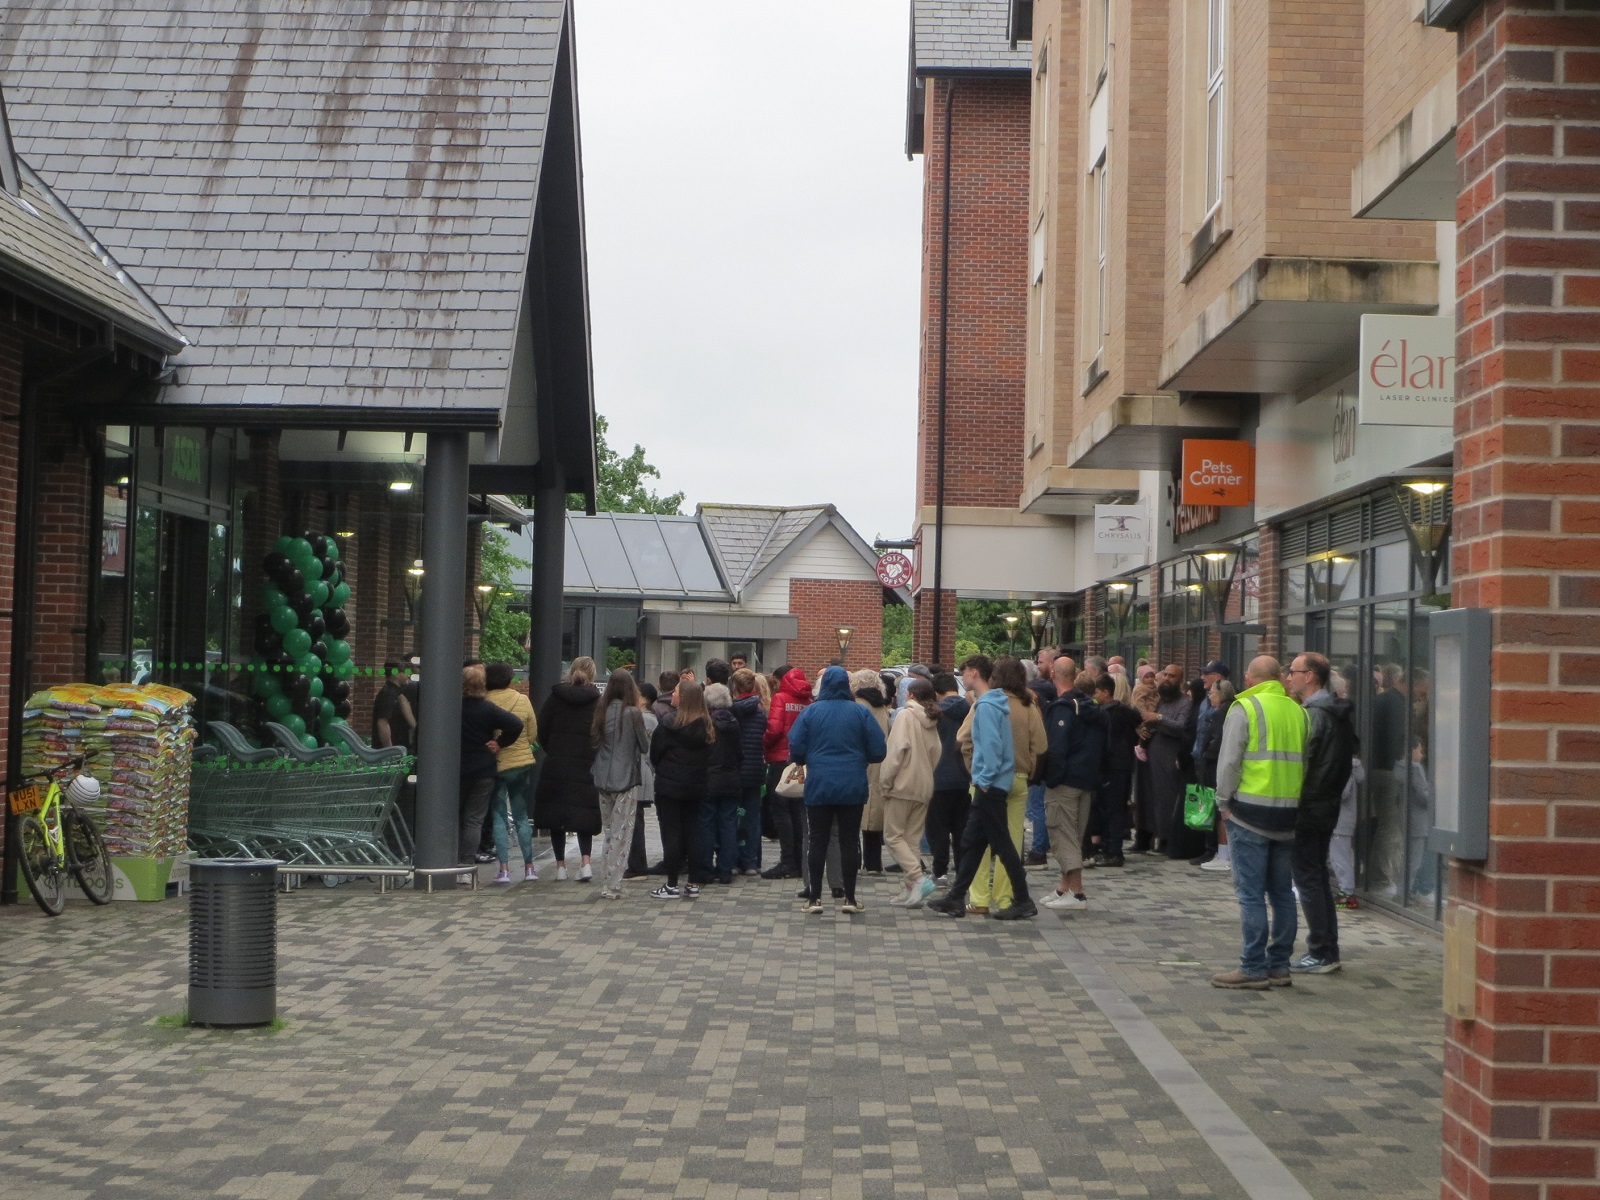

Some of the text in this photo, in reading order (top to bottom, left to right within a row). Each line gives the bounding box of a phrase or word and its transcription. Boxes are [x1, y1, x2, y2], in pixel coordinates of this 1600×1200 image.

[1202, 459, 1232, 474] Pets
[1190, 471, 1242, 486] Corner
[882, 556, 905, 565] COSTA
[880, 573, 907, 584] COFFEE
